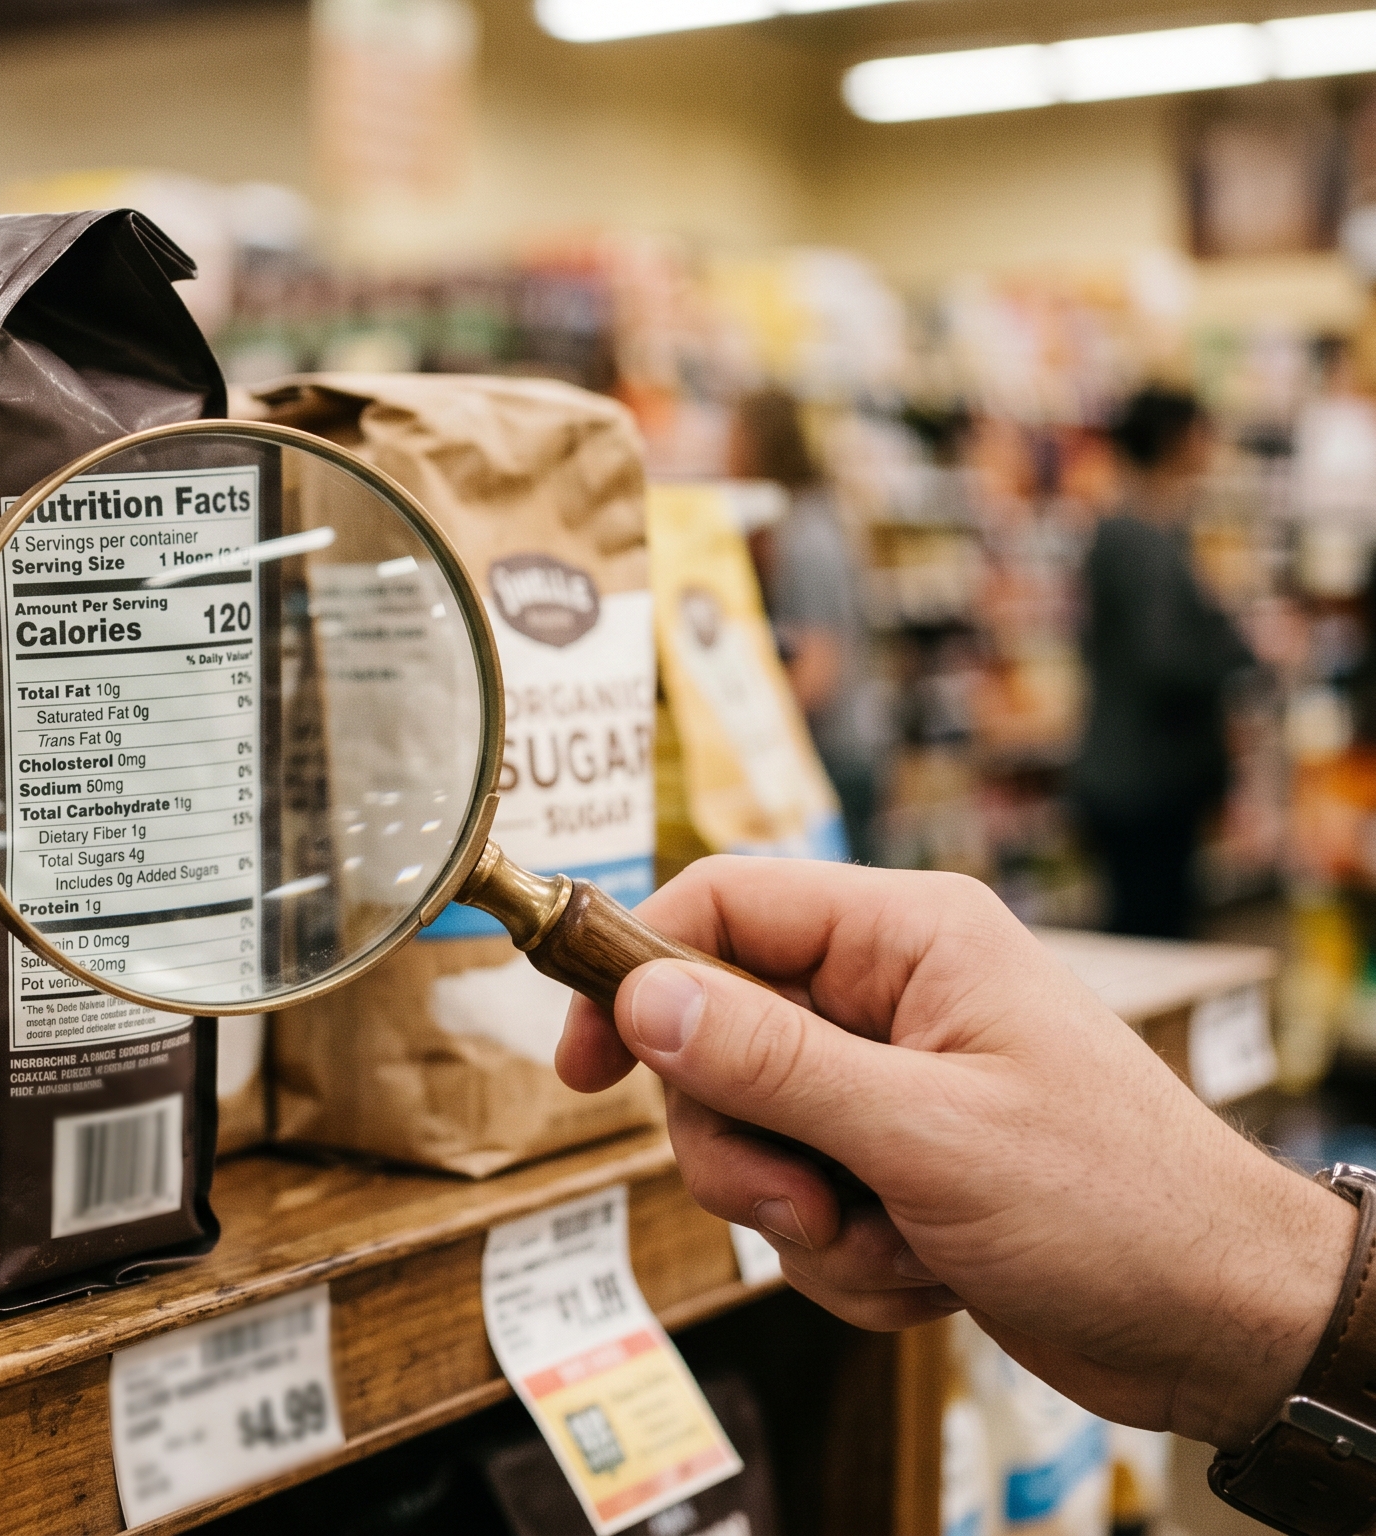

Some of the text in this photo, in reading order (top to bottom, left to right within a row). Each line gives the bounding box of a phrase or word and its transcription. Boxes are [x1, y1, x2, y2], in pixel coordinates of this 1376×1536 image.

[175, 485, 250, 515] Facts
[9, 528, 199, 554] 4 Servings per container
[12, 555, 125, 576] Serving Size
[159, 552, 166, 567] 1
[14, 596, 168, 616] Amount Per Serving
[204, 601, 251, 634] 120
[16, 617, 142, 647] Calories
[199, 653, 224, 666] Daily
[17, 682, 121, 701] Total Fat 10g
[36, 704, 149, 724] Saturated Fat 0g
[38, 730, 122, 748] Trans Fat 0g
[18, 753, 147, 774] Cholosterol 0mg
[19, 779, 124, 798] Sodium 50mg
[19, 805, 62, 821] Total
[66, 798, 171, 818] Carbohydrate
[38, 823, 146, 845] Dietary Fiber 1g
[38, 847, 145, 868] Total Sugars 4g
[55, 863, 220, 891] Includes 0g Added Sugars
[19, 898, 102, 916] Protein 1g
[78, 935, 89, 949] D
[93, 934, 130, 949] 0mcg
[21, 977, 45, 991] Pot
[237, 1379, 327, 1449] $4.99
